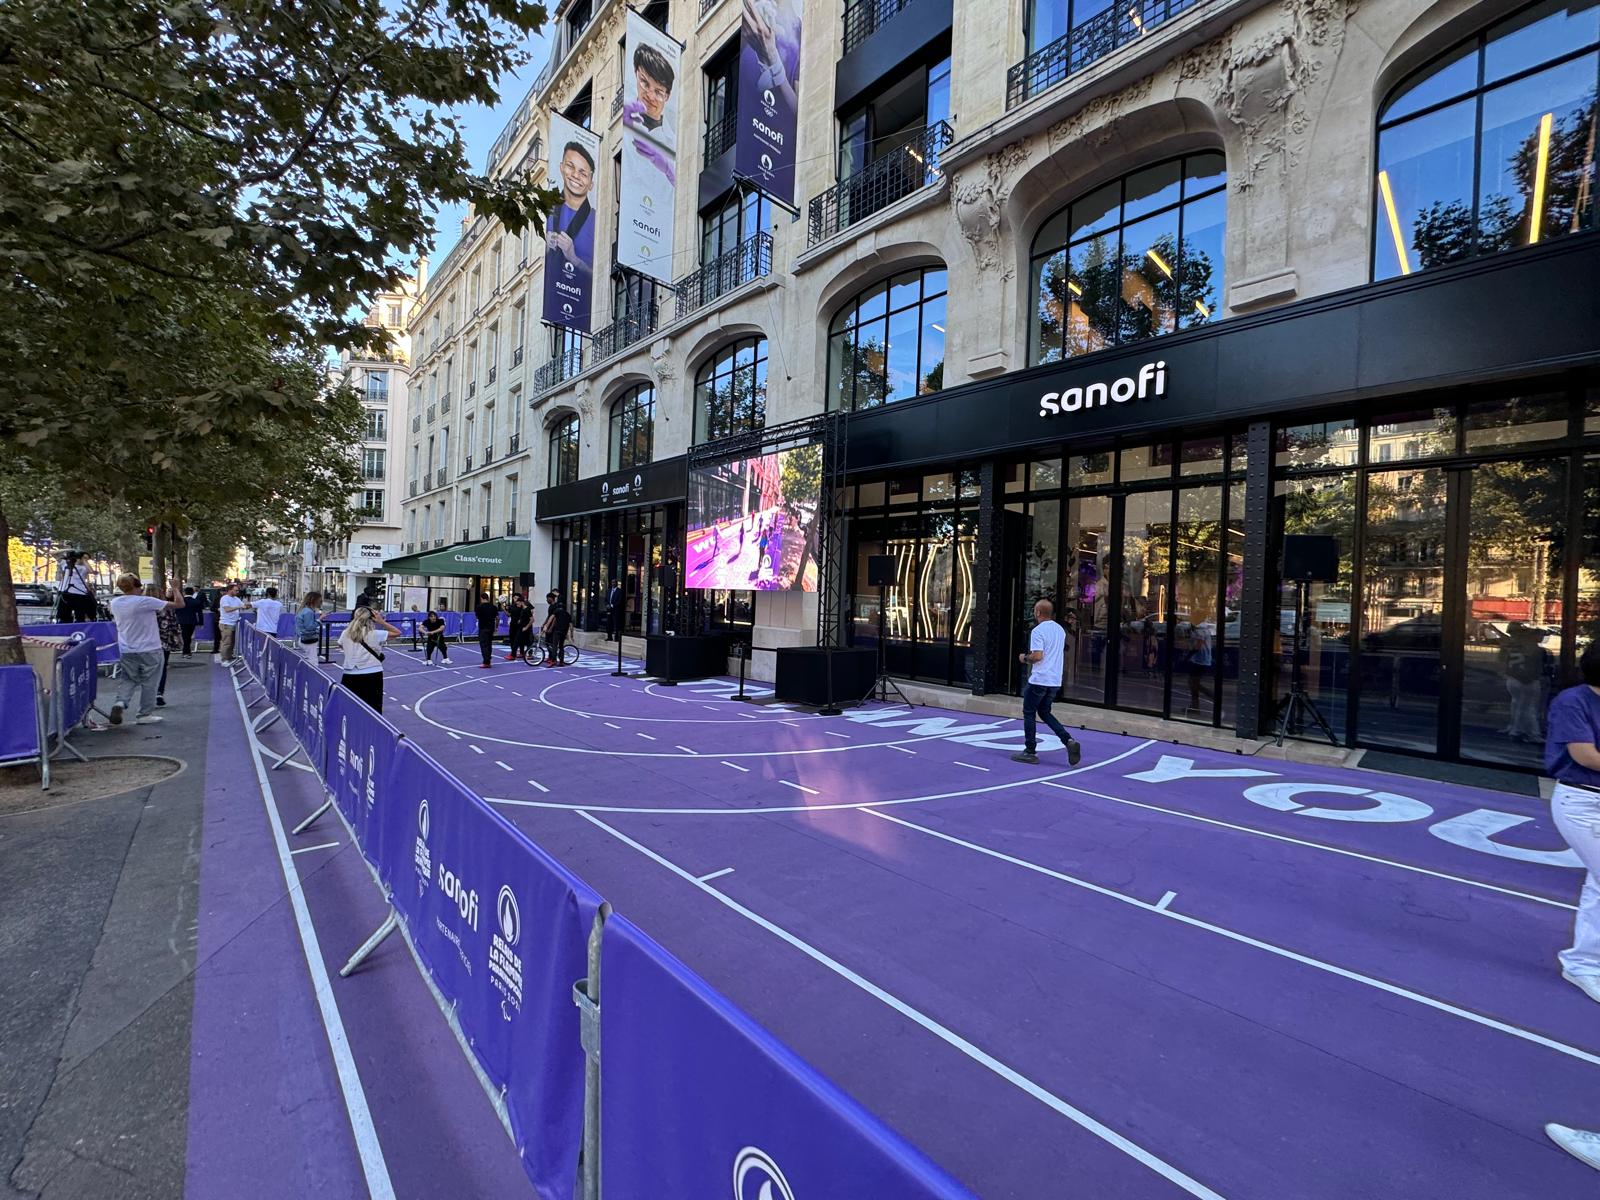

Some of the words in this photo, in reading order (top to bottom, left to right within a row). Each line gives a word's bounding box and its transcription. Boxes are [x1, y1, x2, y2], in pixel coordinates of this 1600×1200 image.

[752, 117, 784, 146] sanofi
[632, 218, 662, 238] sanofi
[555, 281, 582, 296] sanofi
[1039, 360, 1166, 417] sanofi
[612, 483, 630, 496] sanofi
[454, 554, 503, 564] Class'croute
[438, 862, 479, 933] sanofi
[489, 945, 499, 963] LA
[493, 933, 514, 963] RELAIS
[513, 954, 522, 973] DE
